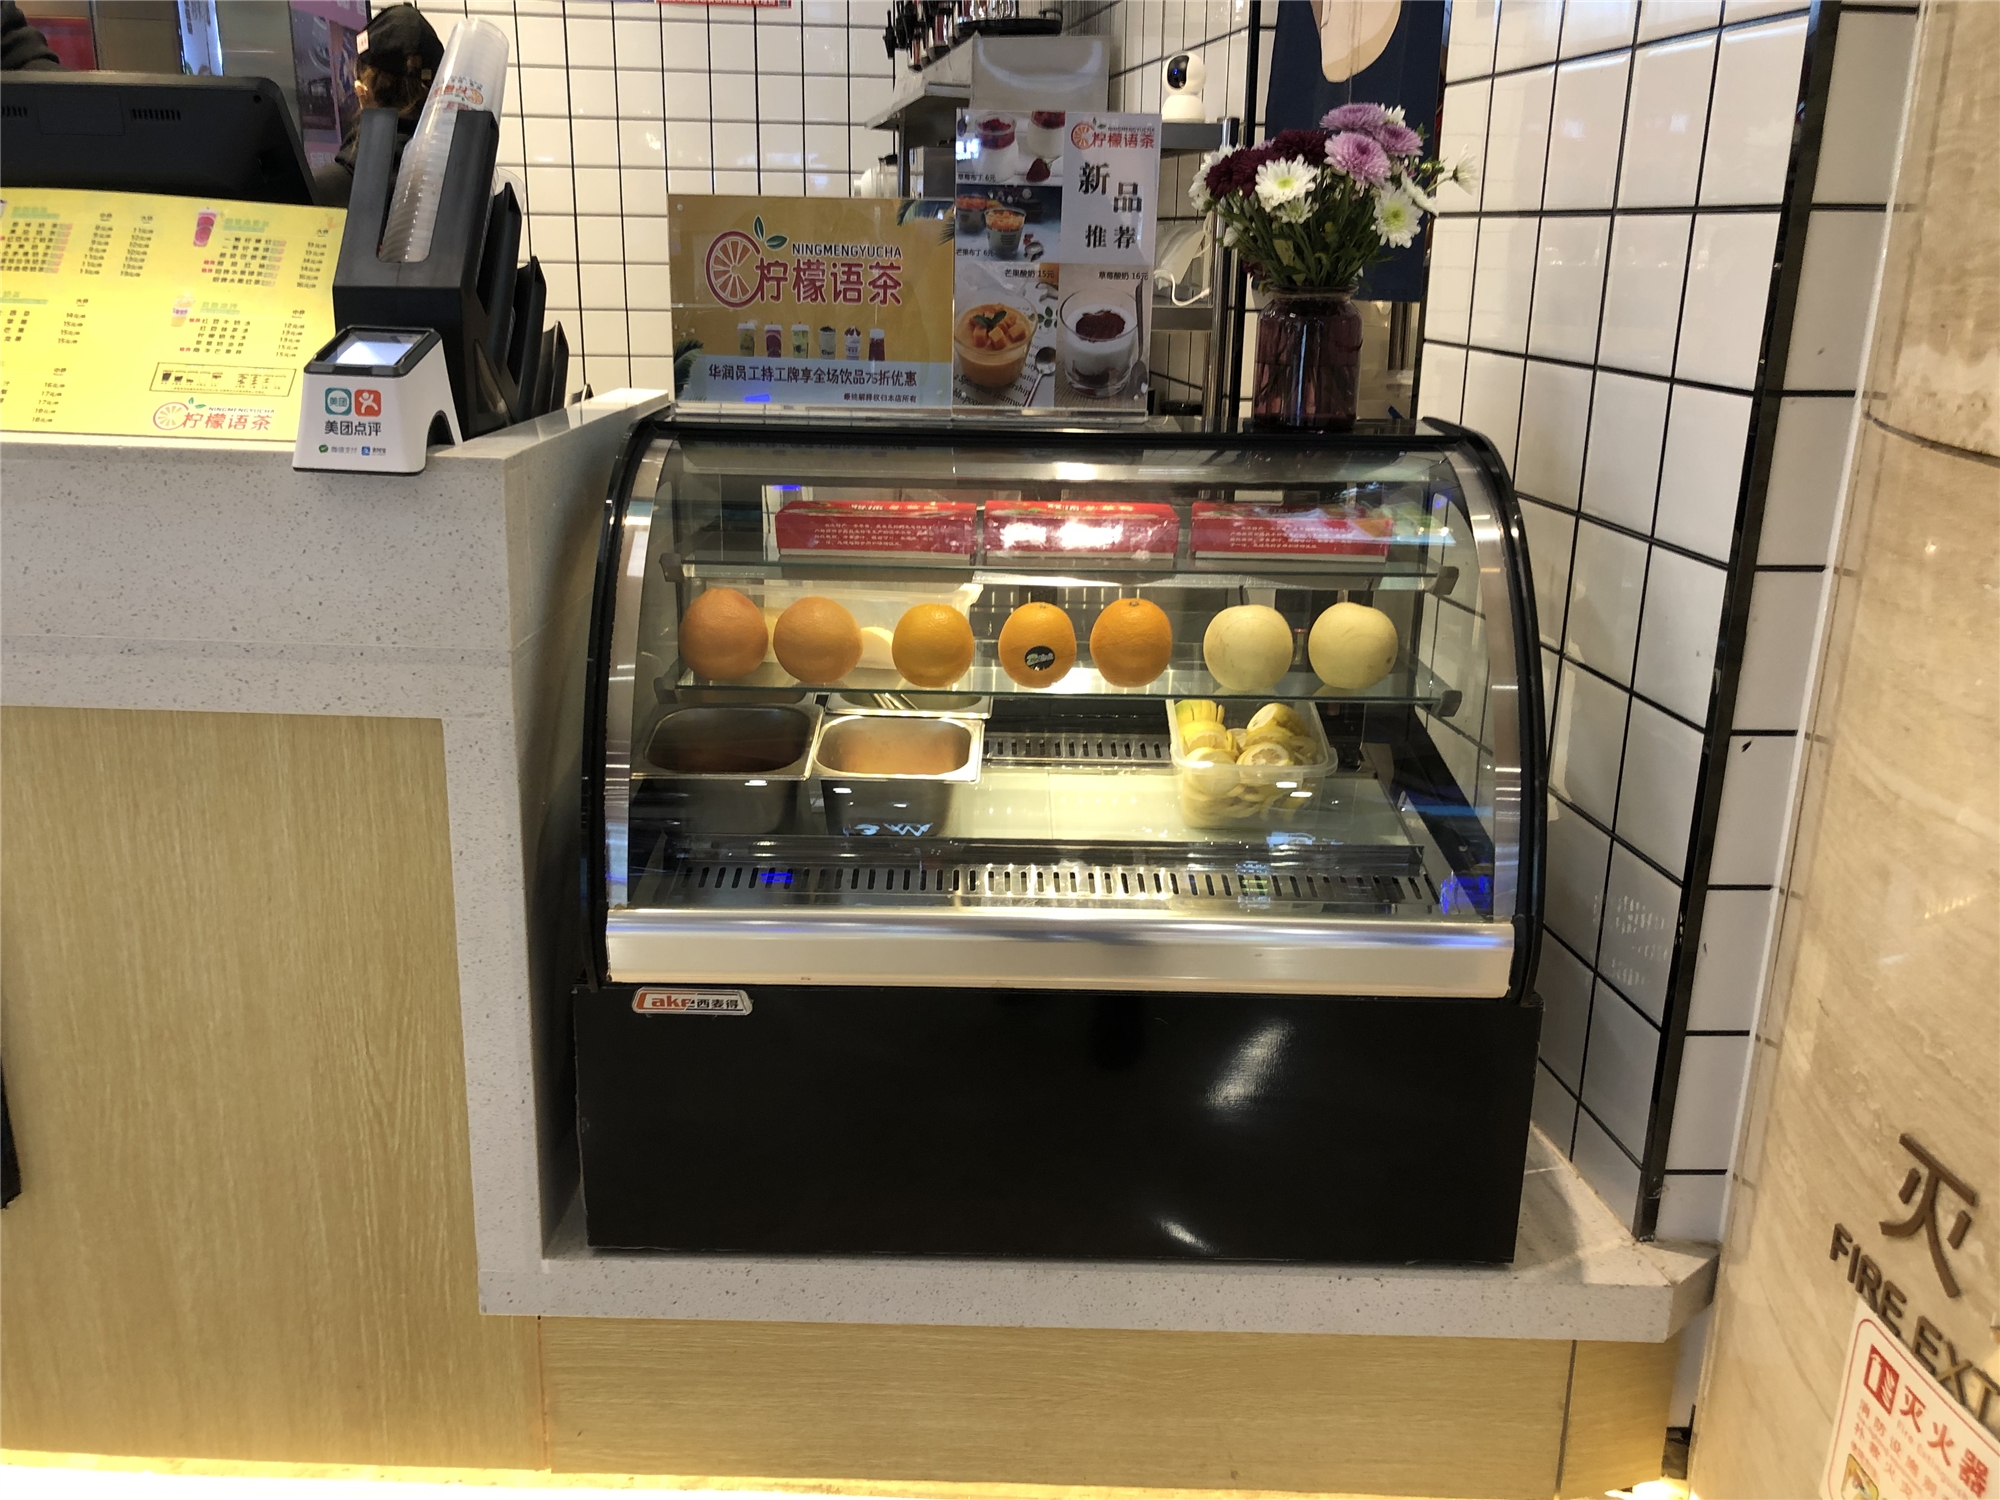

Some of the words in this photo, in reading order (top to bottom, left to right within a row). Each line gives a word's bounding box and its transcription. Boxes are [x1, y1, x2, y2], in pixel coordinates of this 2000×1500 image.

[1091, 131, 1155, 149] 柠檬语茶
[791, 242, 903, 259] NINGMENGYUCHA
[754, 256, 903, 306] 柠檬语茶
[1004, 269, 1035, 279] 芒果酸奶
[1037, 270, 1055, 279] 15元
[1098, 271, 1129, 280] 草莓酸奶
[1132, 272, 1149, 281] 16元
[708, 363, 918, 387] 华润员工持工牌享全场饮品75折优惠
[329, 397, 348, 408] 美团
[843, 393, 917, 404] 最终解释权归本店所有
[182, 412, 273, 432] 柠檬语茶
[324, 420, 382, 437] 美团点评
[696, 998, 739, 1010] 西麦得
[1879, 1133, 1980, 1299] 灭
[1829, 1222, 1909, 1340] FIRE
[1899, 1384, 1990, 1500] 灭火器
